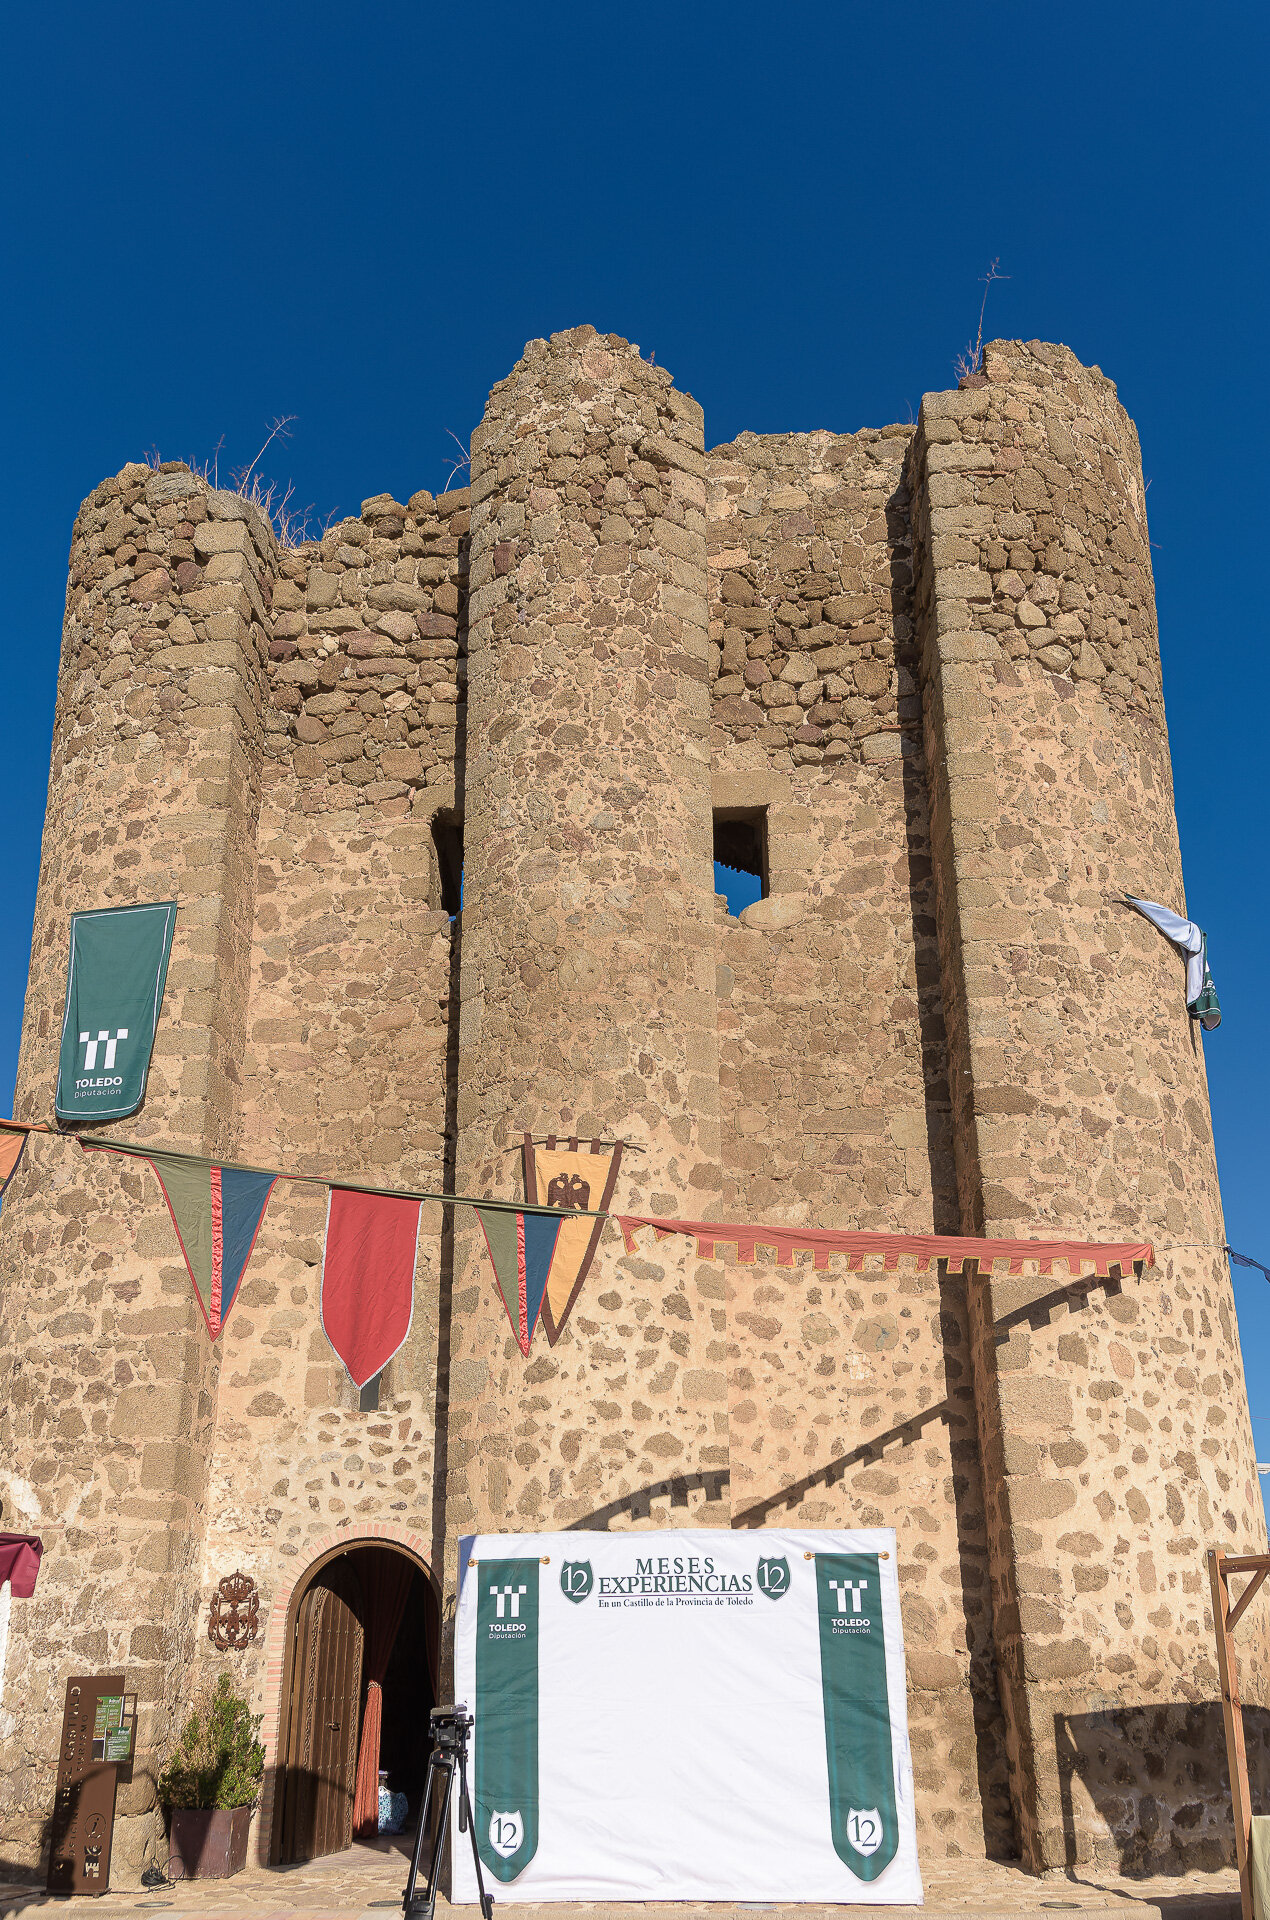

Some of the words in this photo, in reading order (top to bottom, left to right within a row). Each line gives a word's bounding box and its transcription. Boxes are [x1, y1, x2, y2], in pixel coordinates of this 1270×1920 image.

[75, 1076, 123, 1089] TOLEDO
[74, 1088, 122, 1099] Diputación
[636, 1557, 715, 1576] MESES
[562, 1565, 589, 1597] 12
[758, 1561, 787, 1593] 12
[598, 1574, 752, 1595] EXPERIENCIAS
[598, 1599, 610, 1608] En
[623, 1598, 654, 1608] Castillo
[654, 1598, 665, 1607] de
[666, 1597, 674, 1606] la
[675, 1597, 713, 1606] Provincia
[714, 1597, 725, 1606] de
[726, 1596, 754, 1606] Toledo
[489, 1623, 527, 1632] TOLEDO
[831, 1618, 871, 1627] TOLEDO
[489, 1632, 526, 1640] Diputación
[832, 1627, 871, 1635] Diputación
[492, 1817, 518, 1849] 12
[849, 1815, 877, 1847] 12
